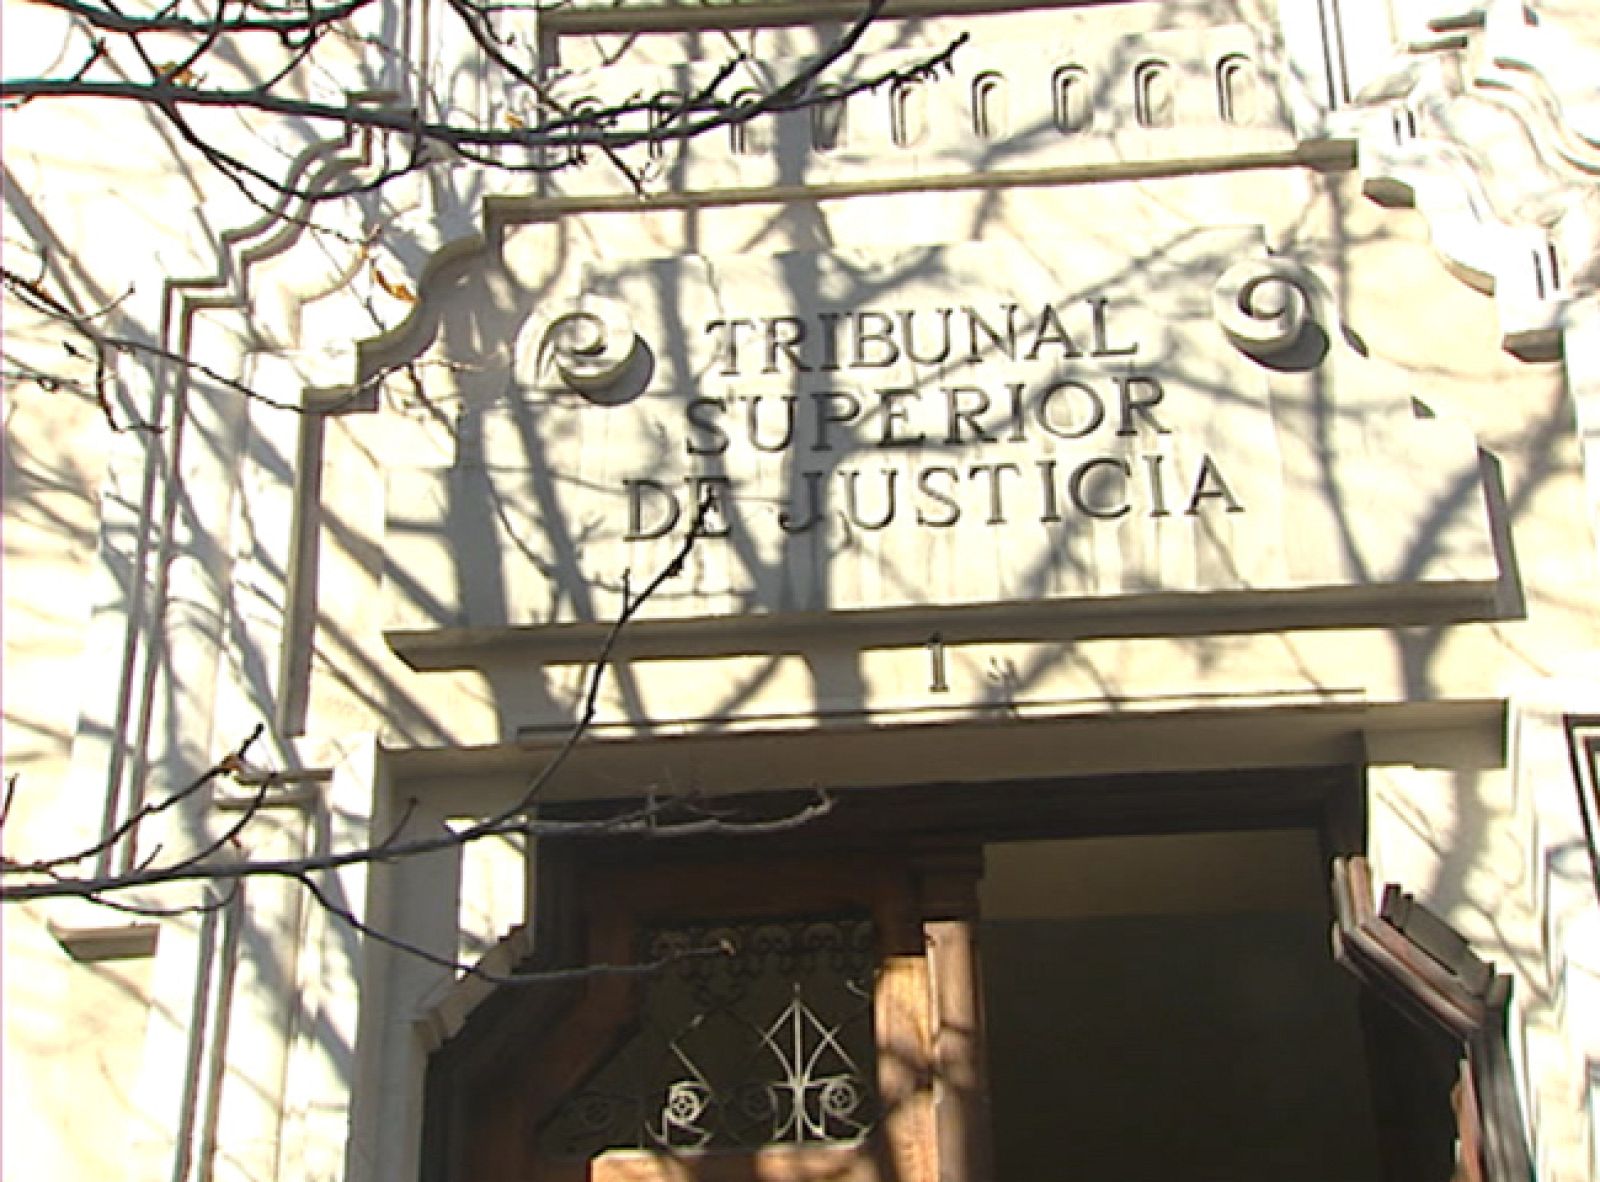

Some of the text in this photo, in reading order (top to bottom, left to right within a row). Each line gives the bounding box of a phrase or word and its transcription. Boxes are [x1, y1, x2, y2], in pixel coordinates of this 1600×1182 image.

[704, 298, 1139, 376] TRIBUNAL
[685, 376, 1172, 456] SUPERIOR
[622, 454, 1245, 542] DE JUSTICIA
